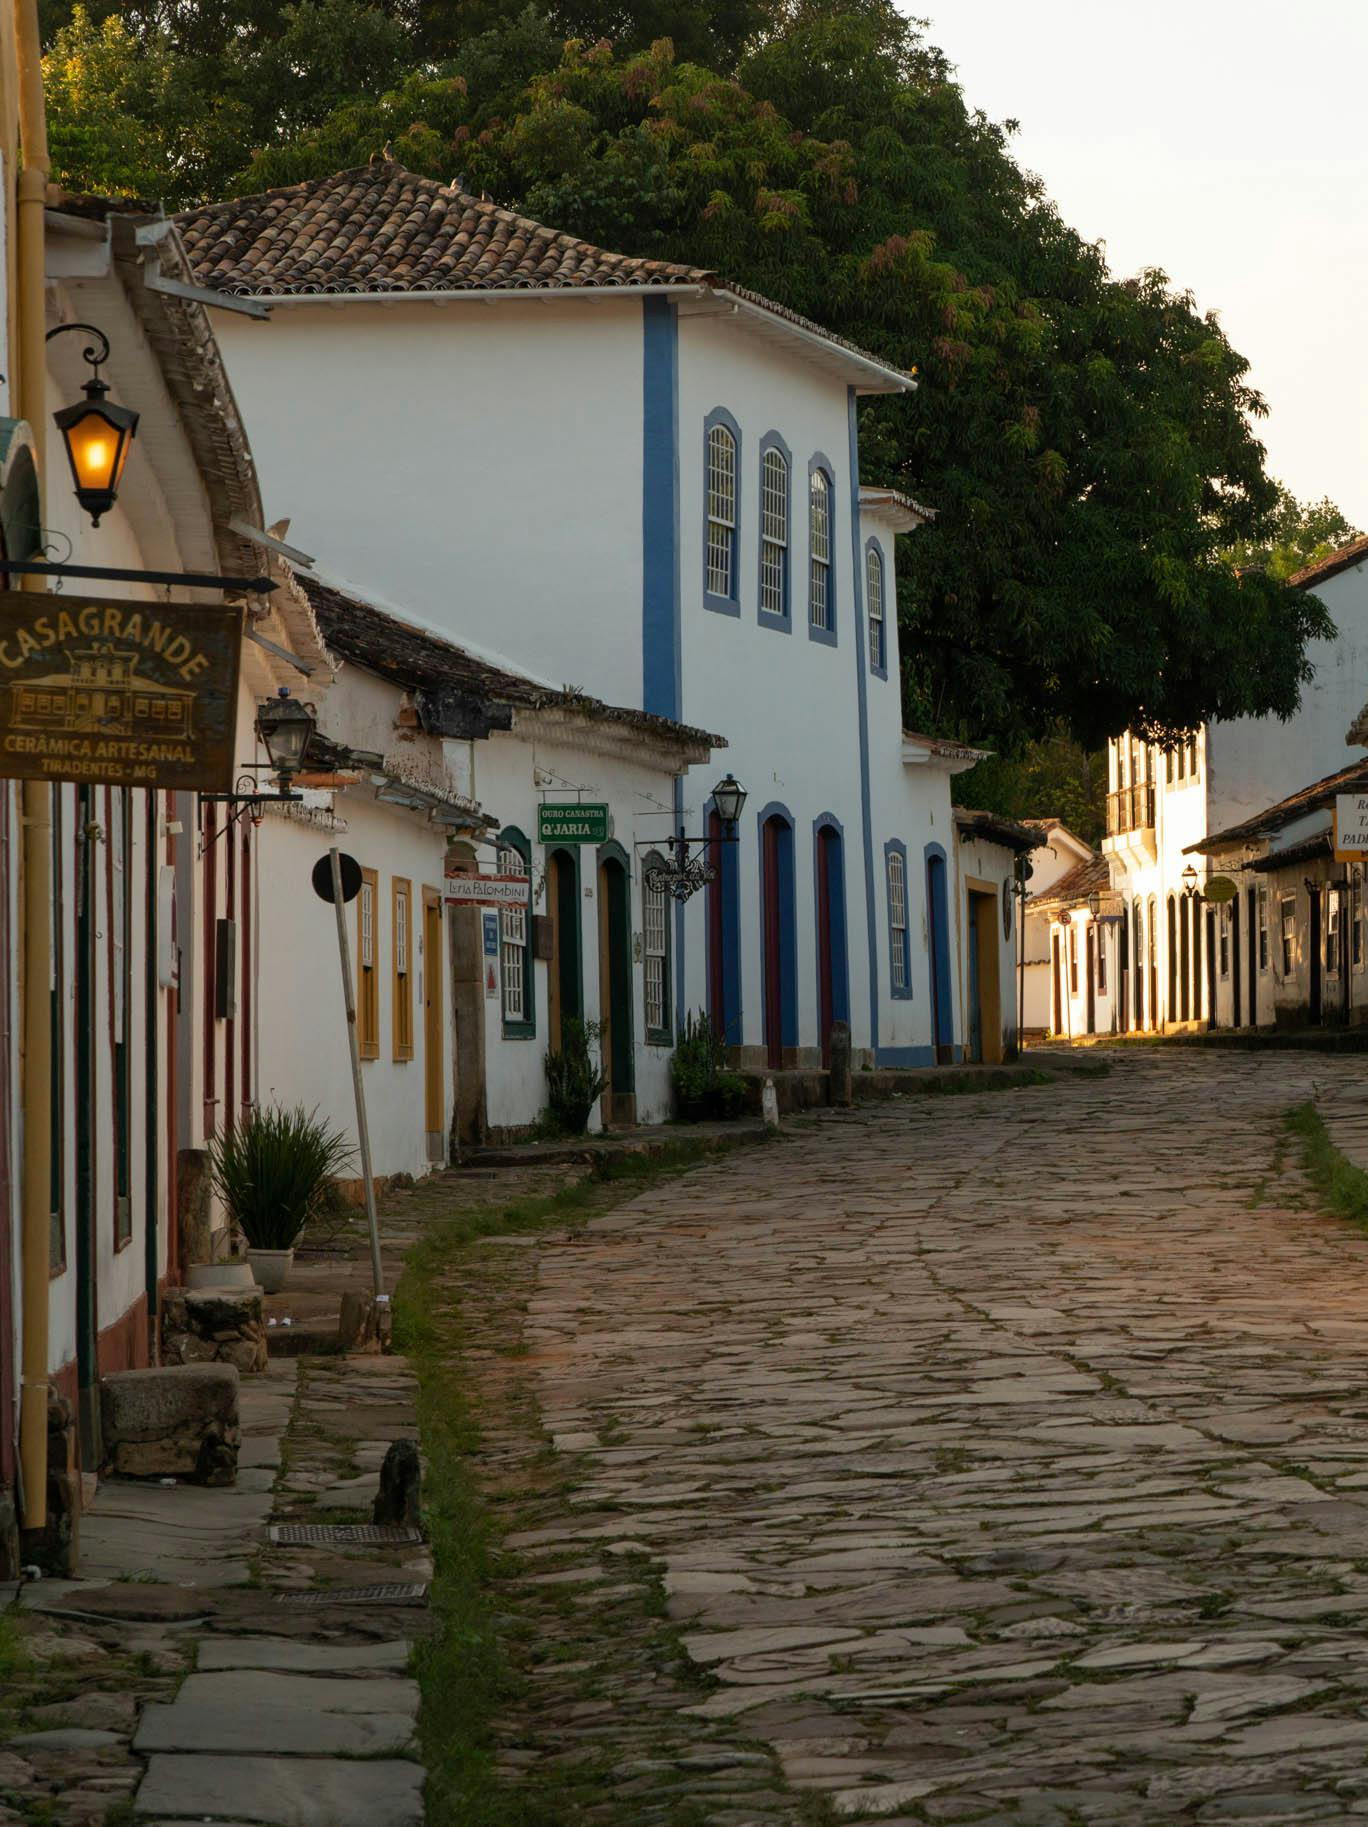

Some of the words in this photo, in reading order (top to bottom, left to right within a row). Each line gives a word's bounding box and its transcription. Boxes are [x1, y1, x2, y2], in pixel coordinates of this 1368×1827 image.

[0, 607, 208, 681] CASAGRANDE
[4, 735, 91, 756] CERÂMICA
[95, 742, 195, 763] ARTESANAL
[41, 759, 122, 777] TIRADENTES
[133, 764, 157, 778] MG
[542, 823, 591, 835] Q'JARIA
